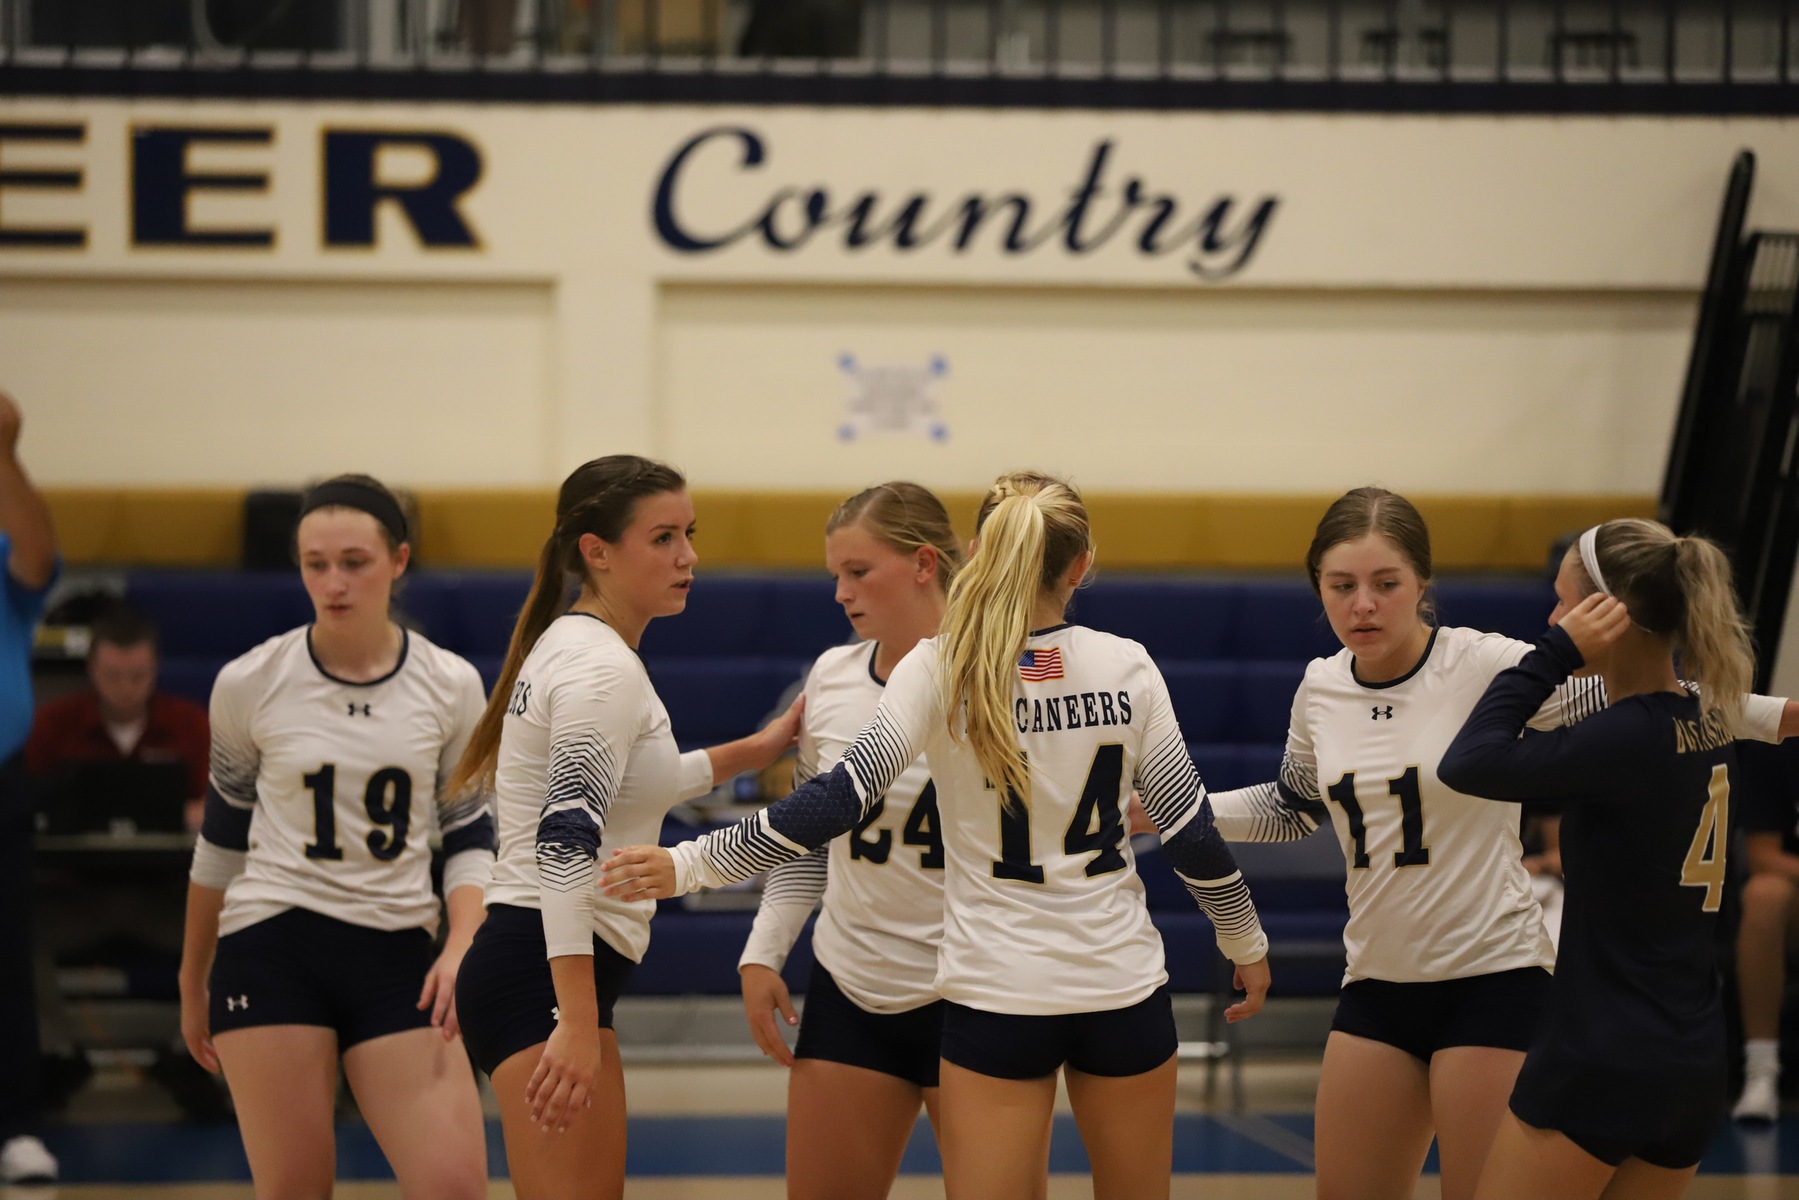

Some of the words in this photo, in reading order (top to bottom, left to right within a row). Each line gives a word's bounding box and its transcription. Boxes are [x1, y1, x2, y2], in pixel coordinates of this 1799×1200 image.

[650, 124, 1283, 281] Country
[964, 690, 1132, 734] CANEERS
[302, 762, 413, 862] 19
[982, 741, 1126, 884] 14
[1326, 764, 1431, 871] 11
[1679, 763, 1730, 912] 4
